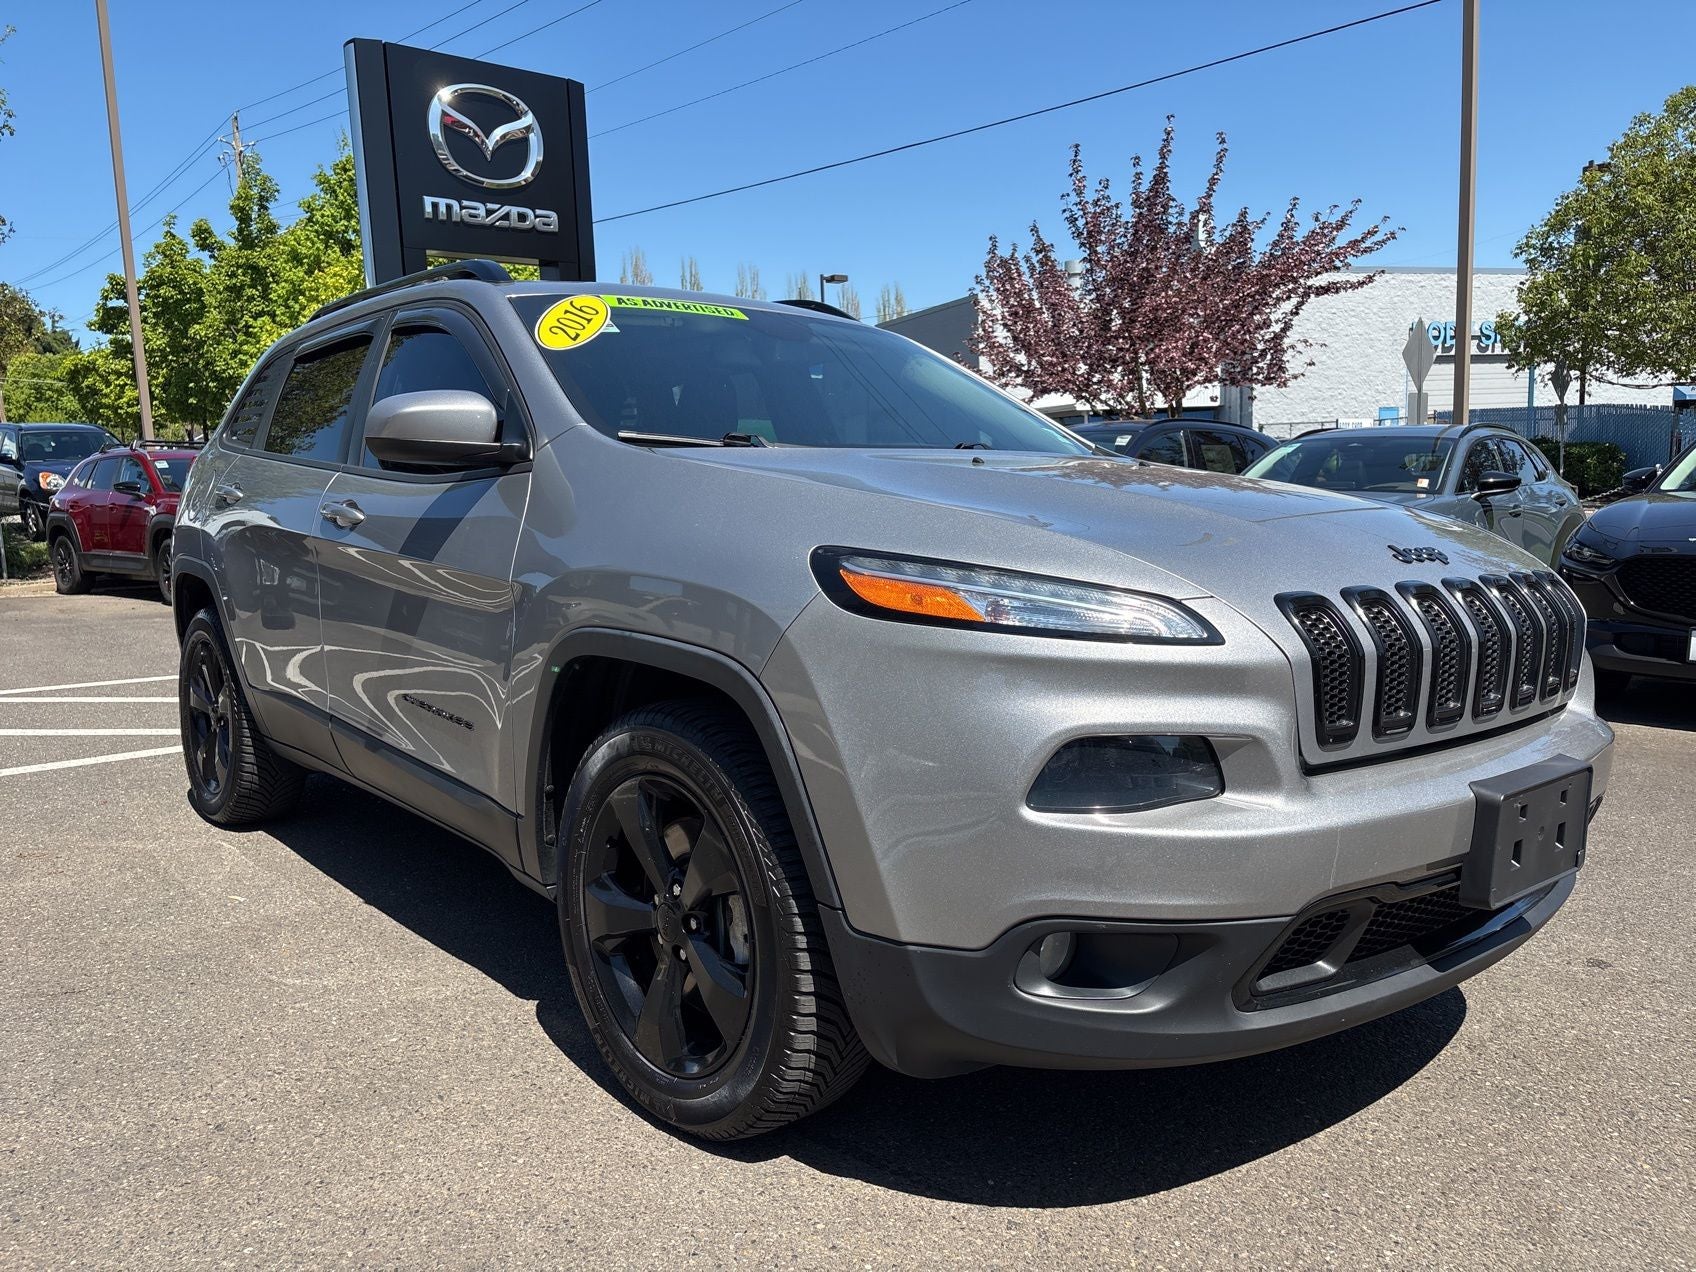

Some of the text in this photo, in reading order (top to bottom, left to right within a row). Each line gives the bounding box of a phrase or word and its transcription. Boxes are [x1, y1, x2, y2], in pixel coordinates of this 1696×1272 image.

[423, 195, 559, 232] mazda
[550, 301, 600, 342] 2016
[616, 297, 734, 317] AS ADVERTISED
[1387, 544, 1450, 565] Jeep
